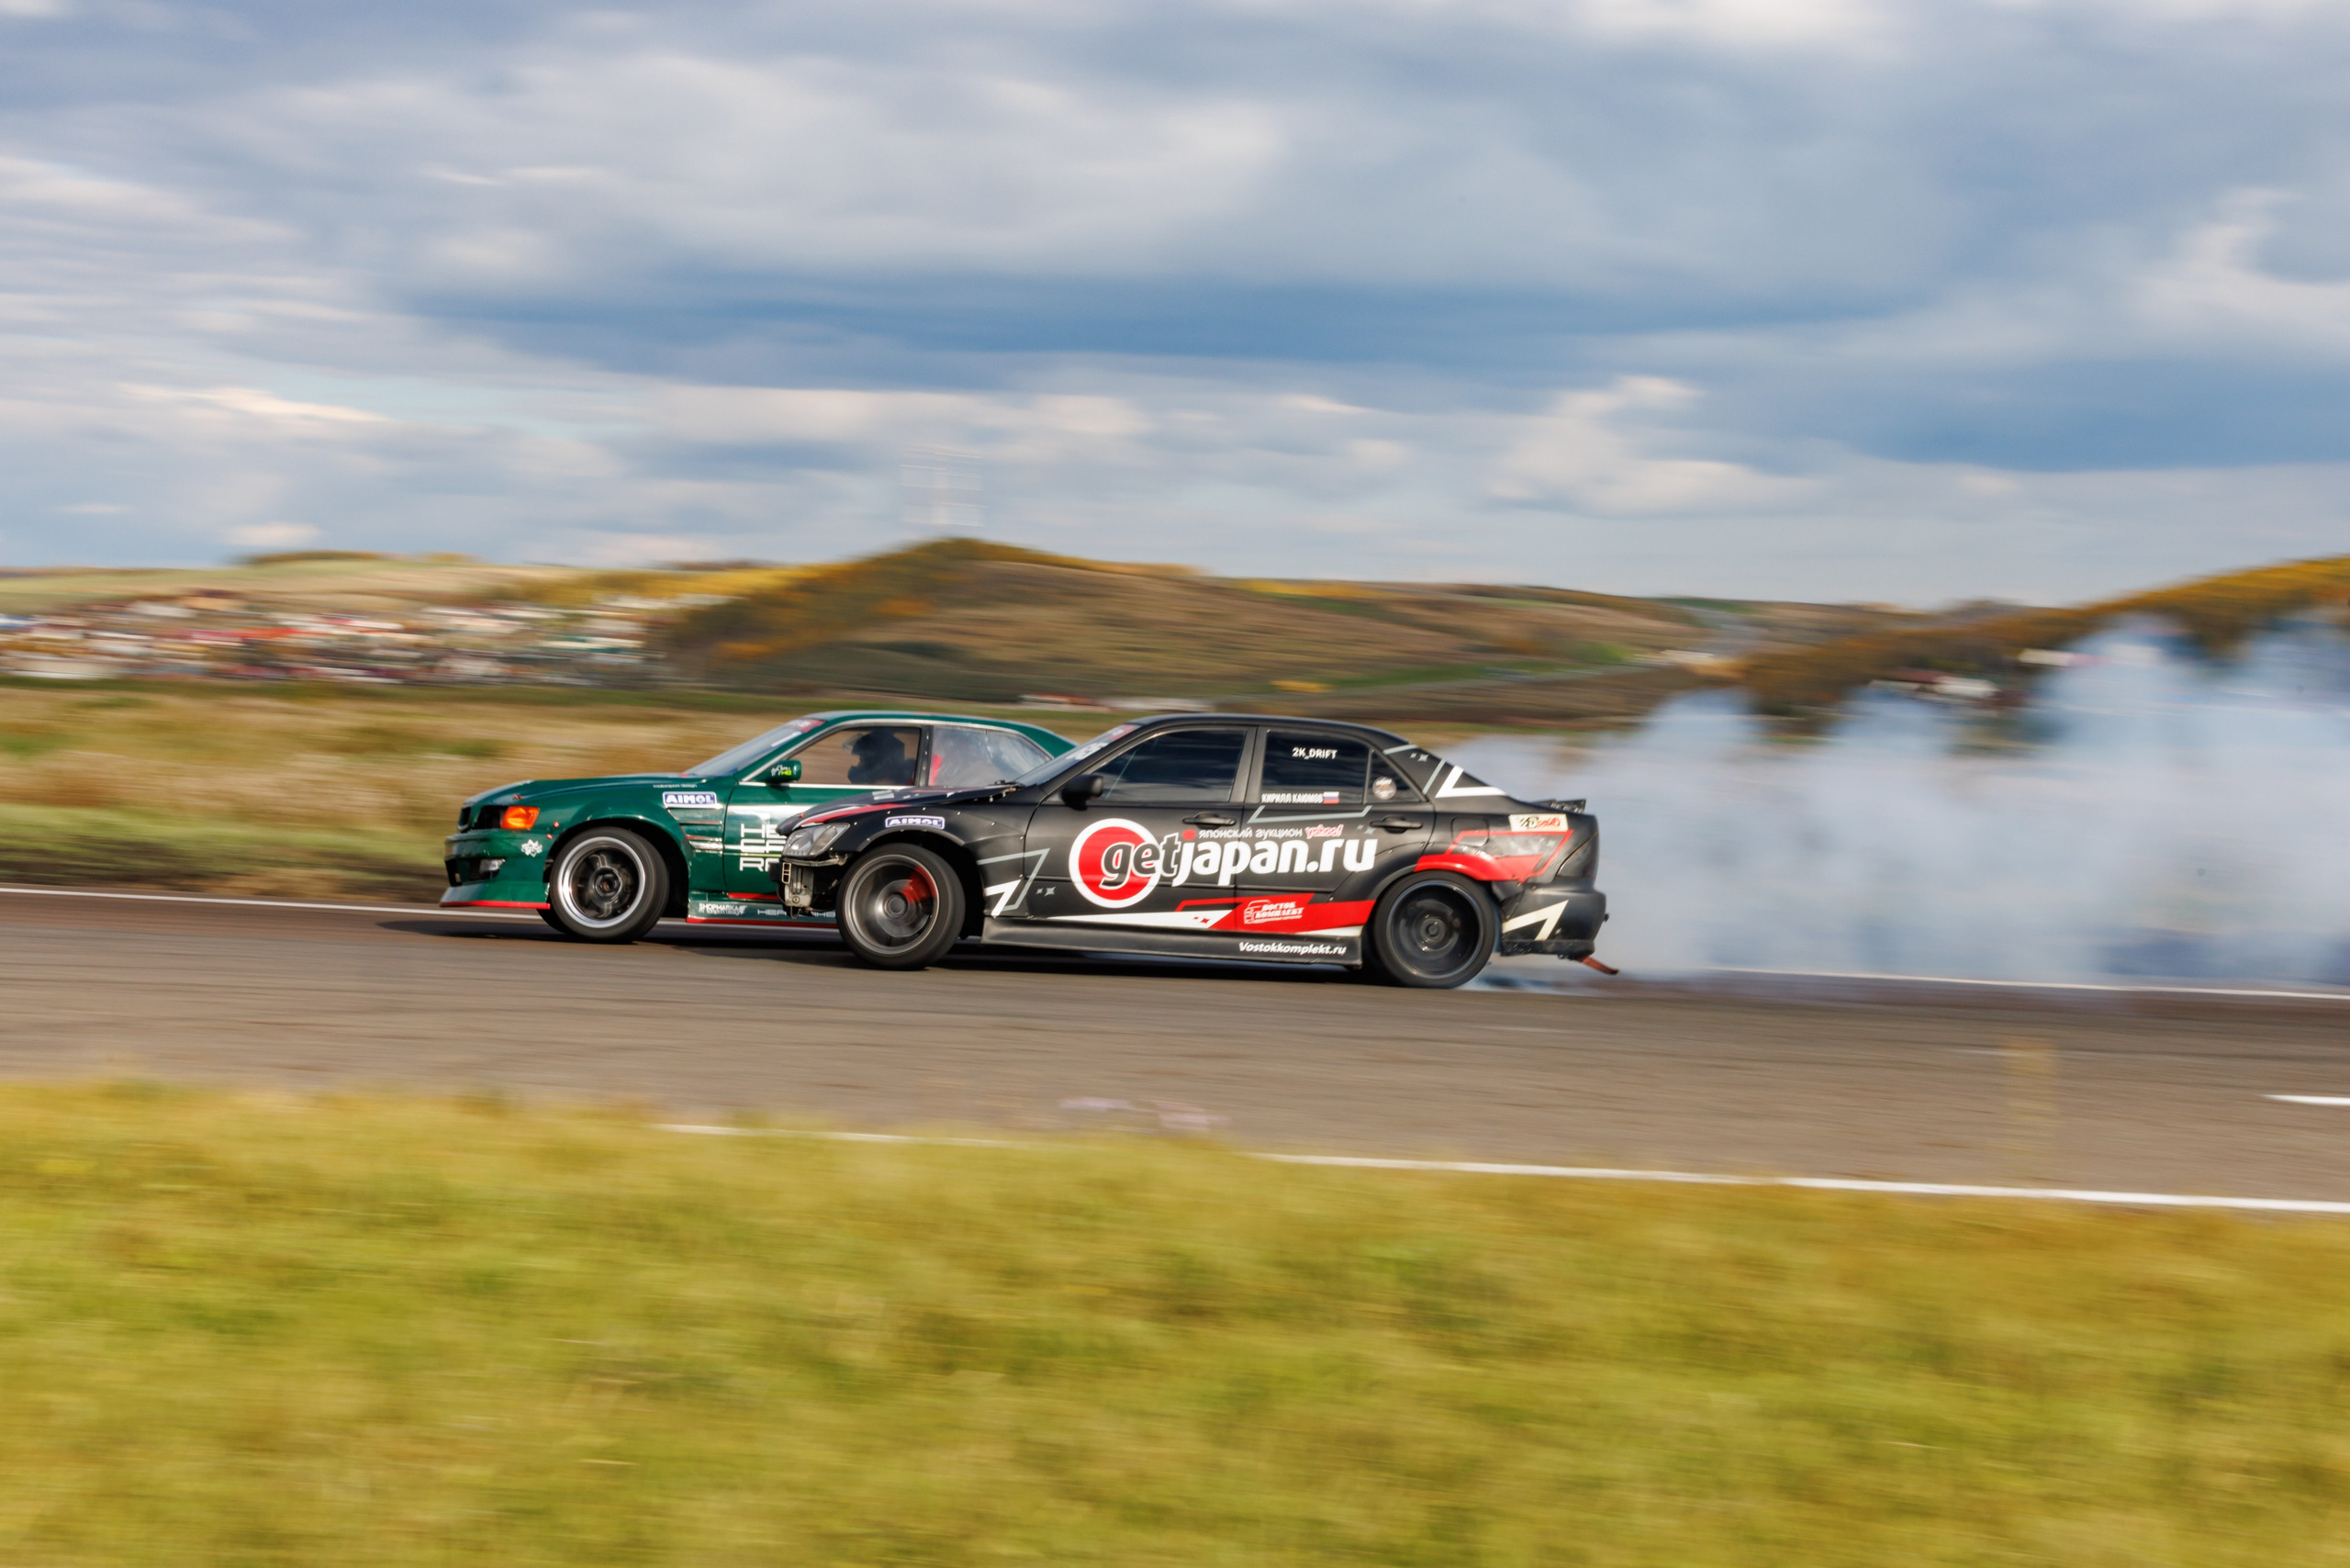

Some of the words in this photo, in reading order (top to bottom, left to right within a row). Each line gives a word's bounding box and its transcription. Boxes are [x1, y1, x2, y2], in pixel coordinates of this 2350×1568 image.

[1292, 746, 1338, 760] 2K_DRIFT
[666, 794, 715, 805] AIMOL
[888, 818, 941, 826] AIMOL
[1255, 828, 1304, 841] аукцион
[1099, 829, 1379, 890] getjapan.ru
[1261, 901, 1296, 912] ВОСТОК
[1255, 907, 1305, 919] КОМПЛЕКТ
[1238, 941, 1348, 956] Vostokkomplekt.ru
